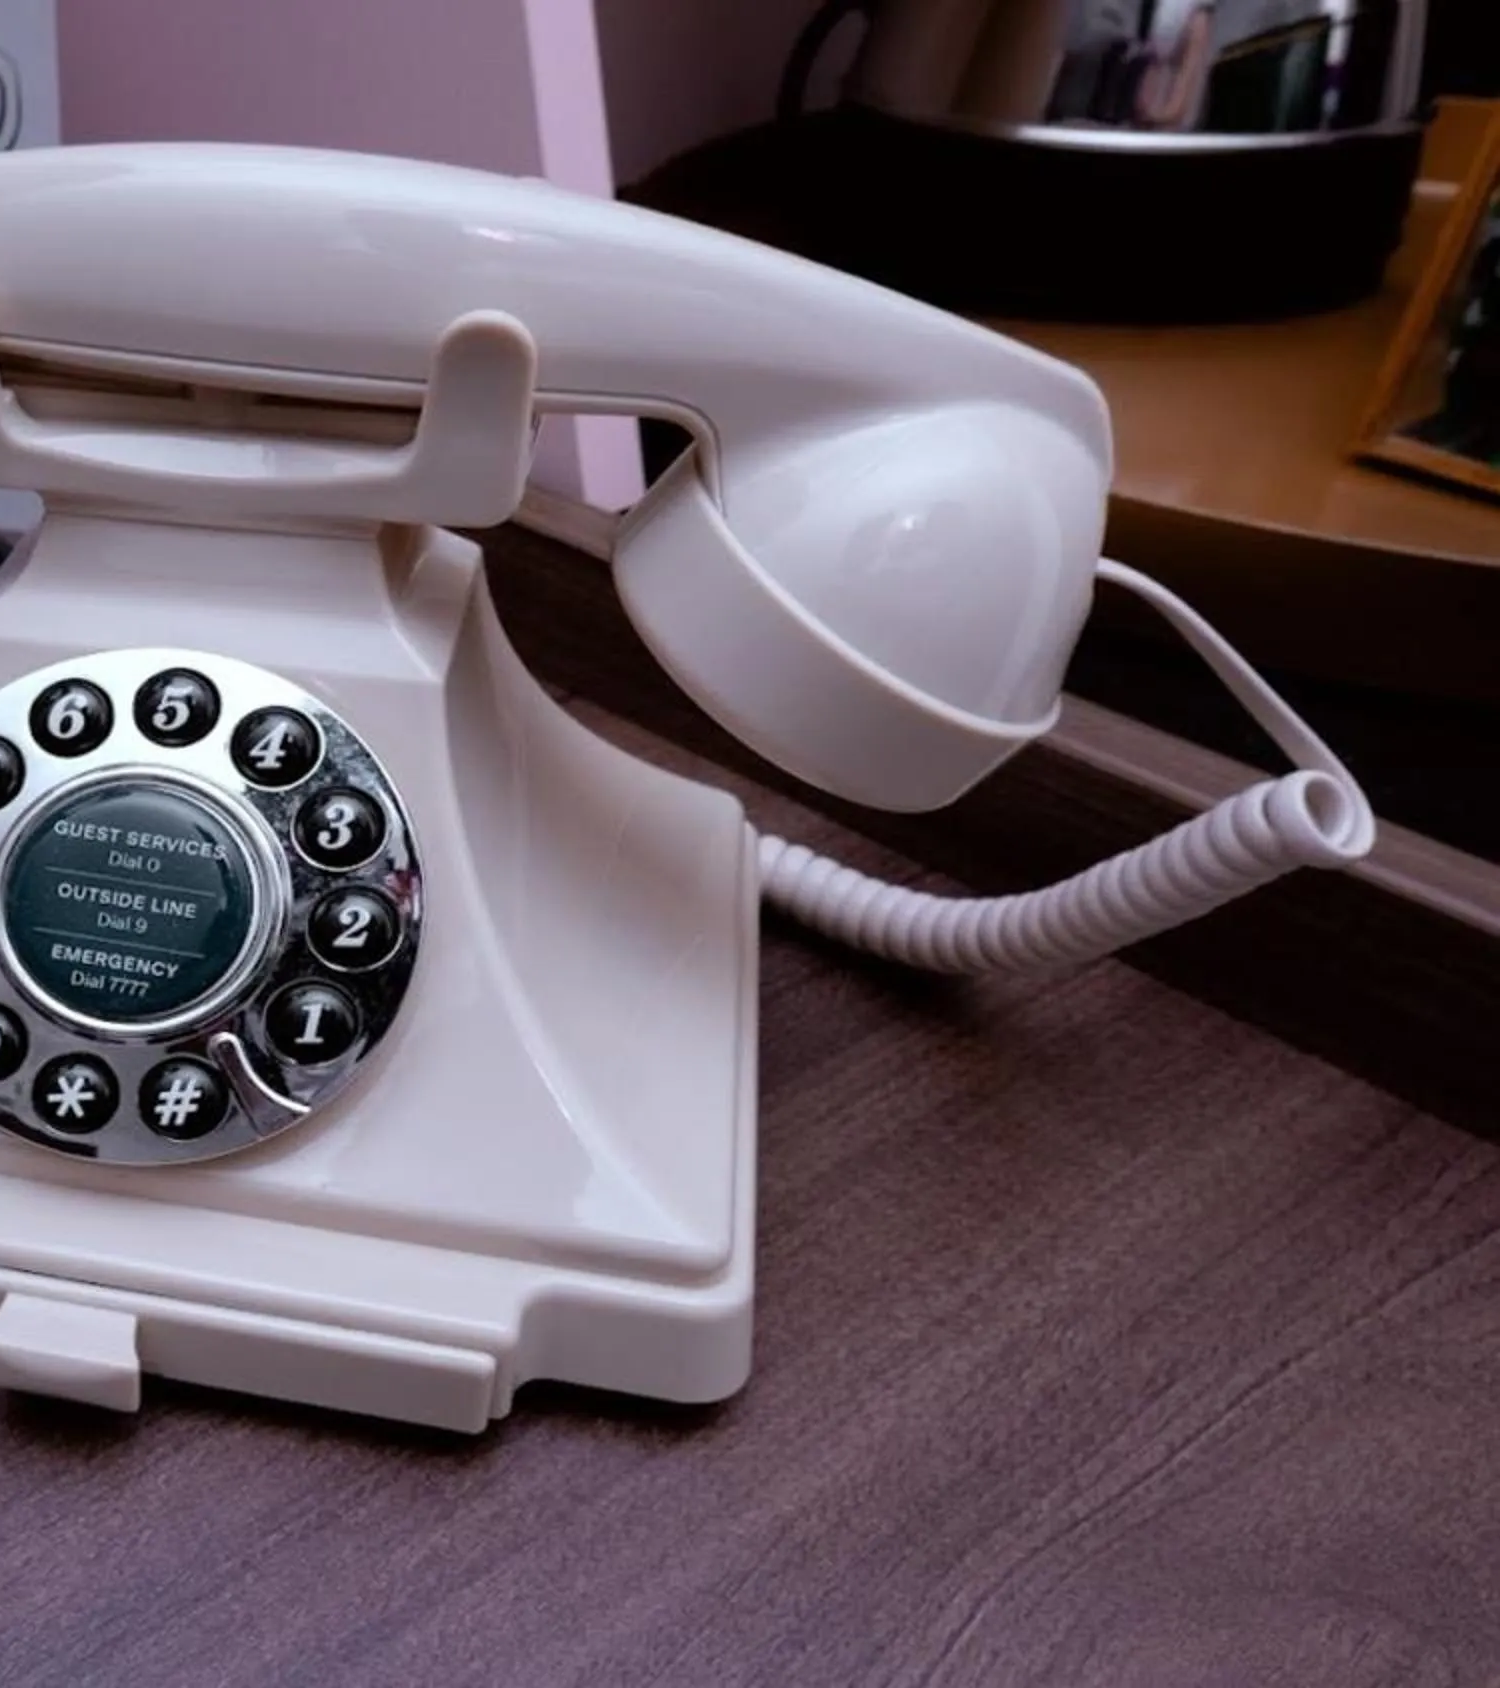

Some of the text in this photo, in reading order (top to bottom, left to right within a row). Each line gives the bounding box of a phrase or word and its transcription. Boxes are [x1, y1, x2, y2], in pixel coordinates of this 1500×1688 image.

[48, 690, 88, 739] 6
[152, 685, 195, 731] 5
[249, 720, 289, 768] 4
[53, 819, 228, 861] GUEST SERVICES
[317, 803, 355, 849] 3
[108, 850, 143, 871] Dial
[57, 883, 198, 919] OUTSIDE LINE
[97, 912, 149, 935] Dial 9
[332, 906, 371, 947] 2
[51, 943, 180, 980] EMERGENCY
[70, 969, 150, 998] Dial 7777
[295, 1003, 325, 1044] 1
[154, 1077, 202, 1126] #
